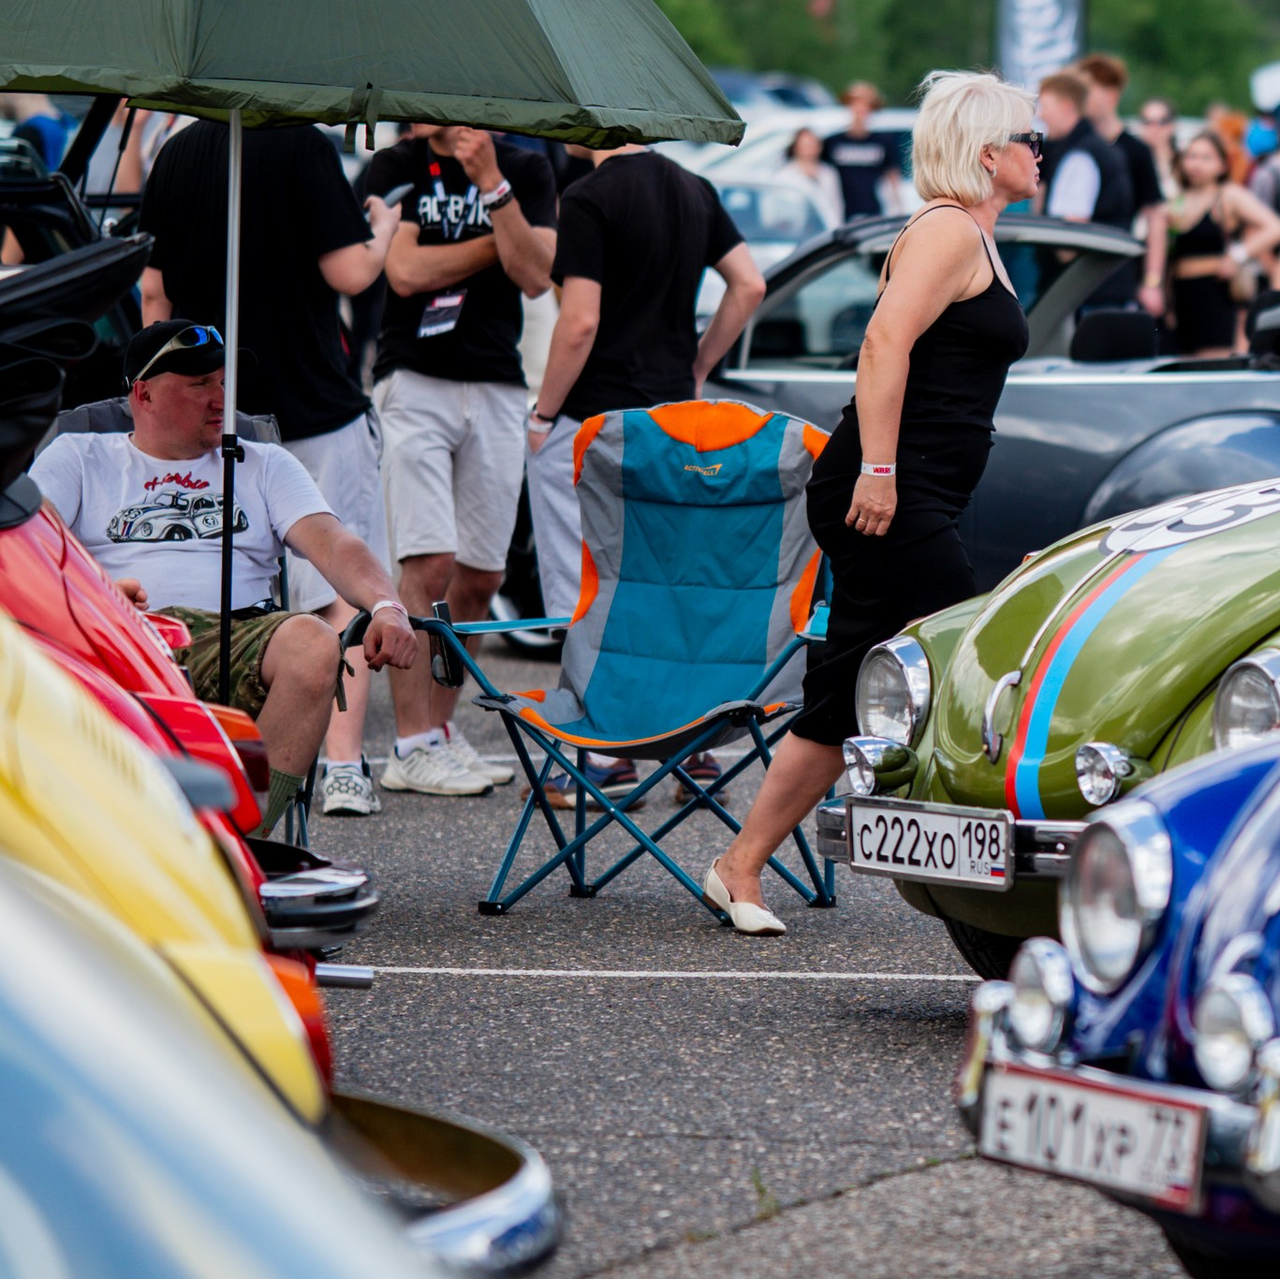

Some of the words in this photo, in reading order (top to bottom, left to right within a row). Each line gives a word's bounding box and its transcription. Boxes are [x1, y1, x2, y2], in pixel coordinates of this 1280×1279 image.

[144, 471, 210, 491] Herbie
[962, 821, 1000, 860] 198
[970, 860, 990, 875] RUS
